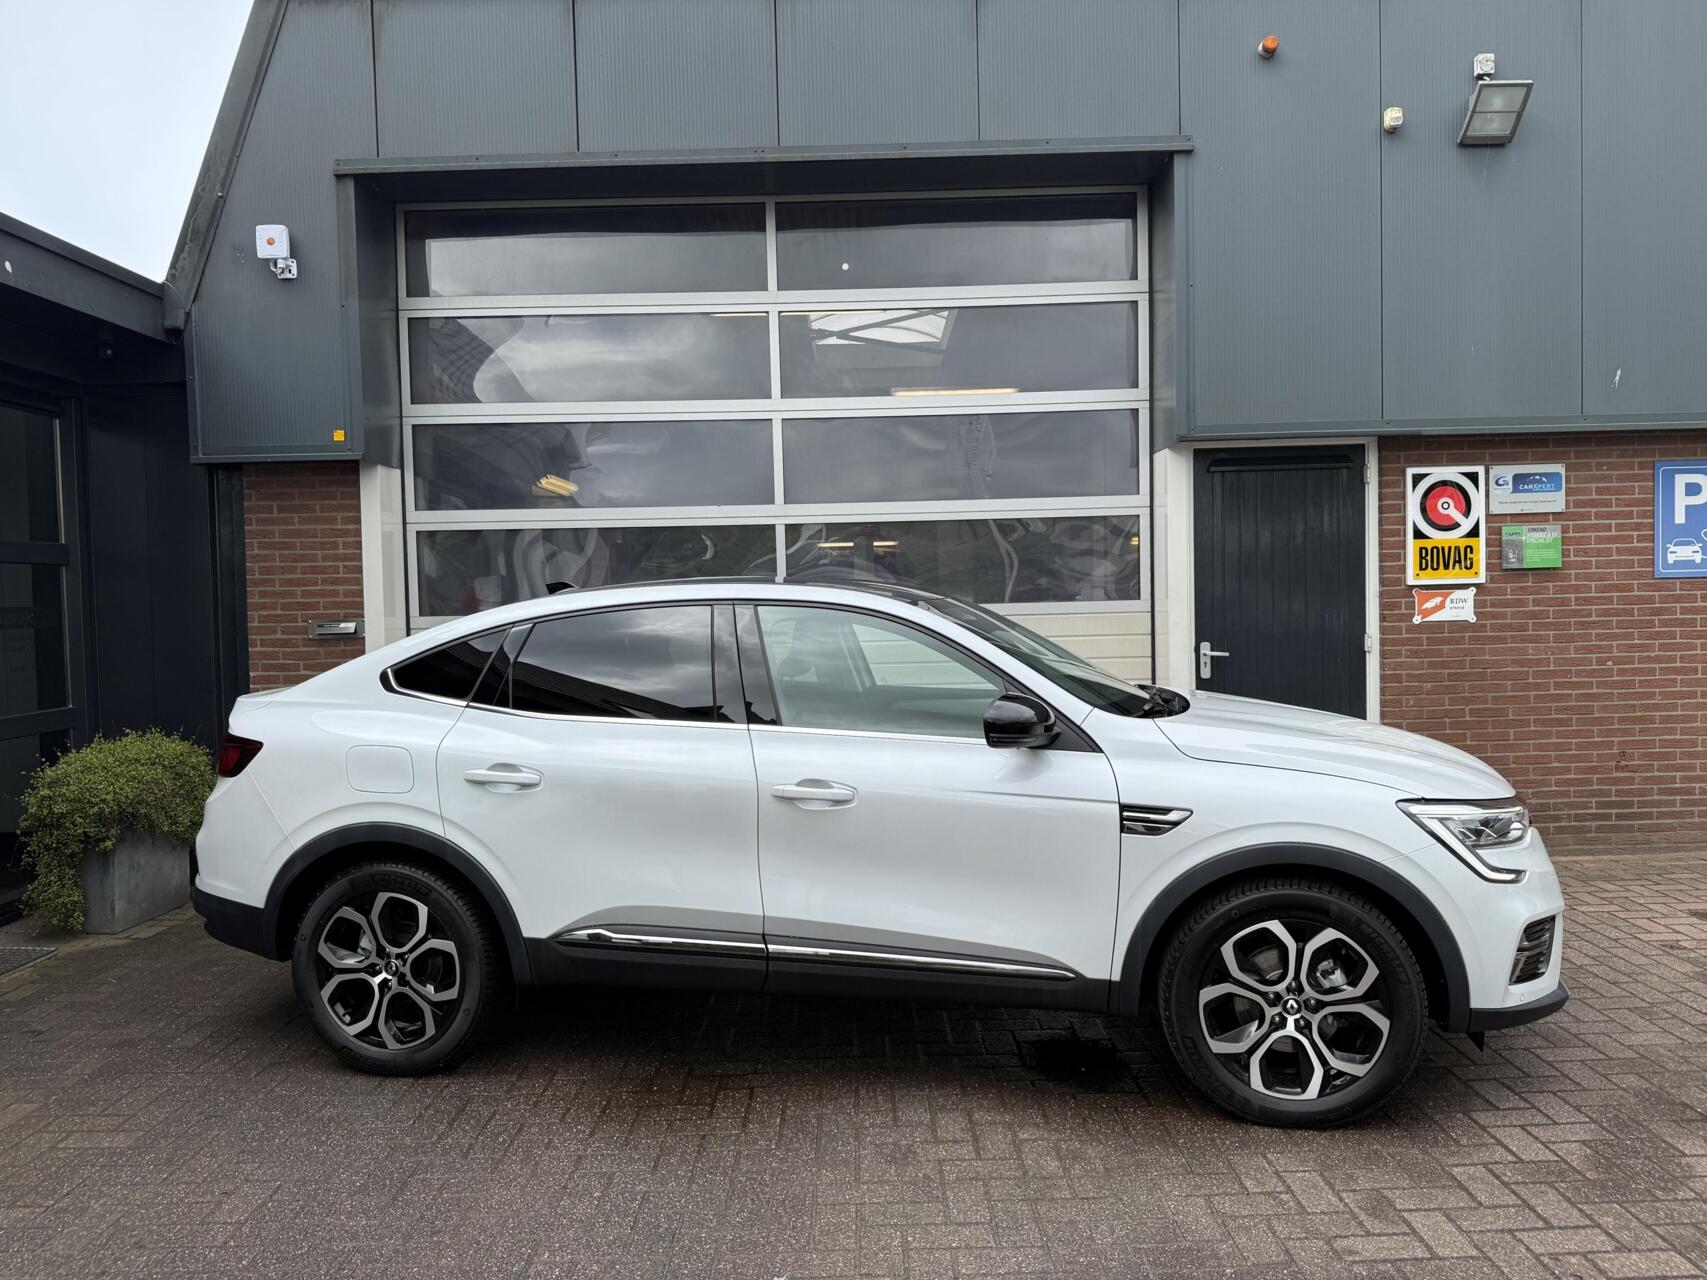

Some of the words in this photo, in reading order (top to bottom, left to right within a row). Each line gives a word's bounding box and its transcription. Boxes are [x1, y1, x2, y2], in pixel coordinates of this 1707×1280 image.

[1674, 473, 1707, 524] P
[1418, 544, 1474, 572] BOVAG
[1449, 597, 1468, 605] RDW
